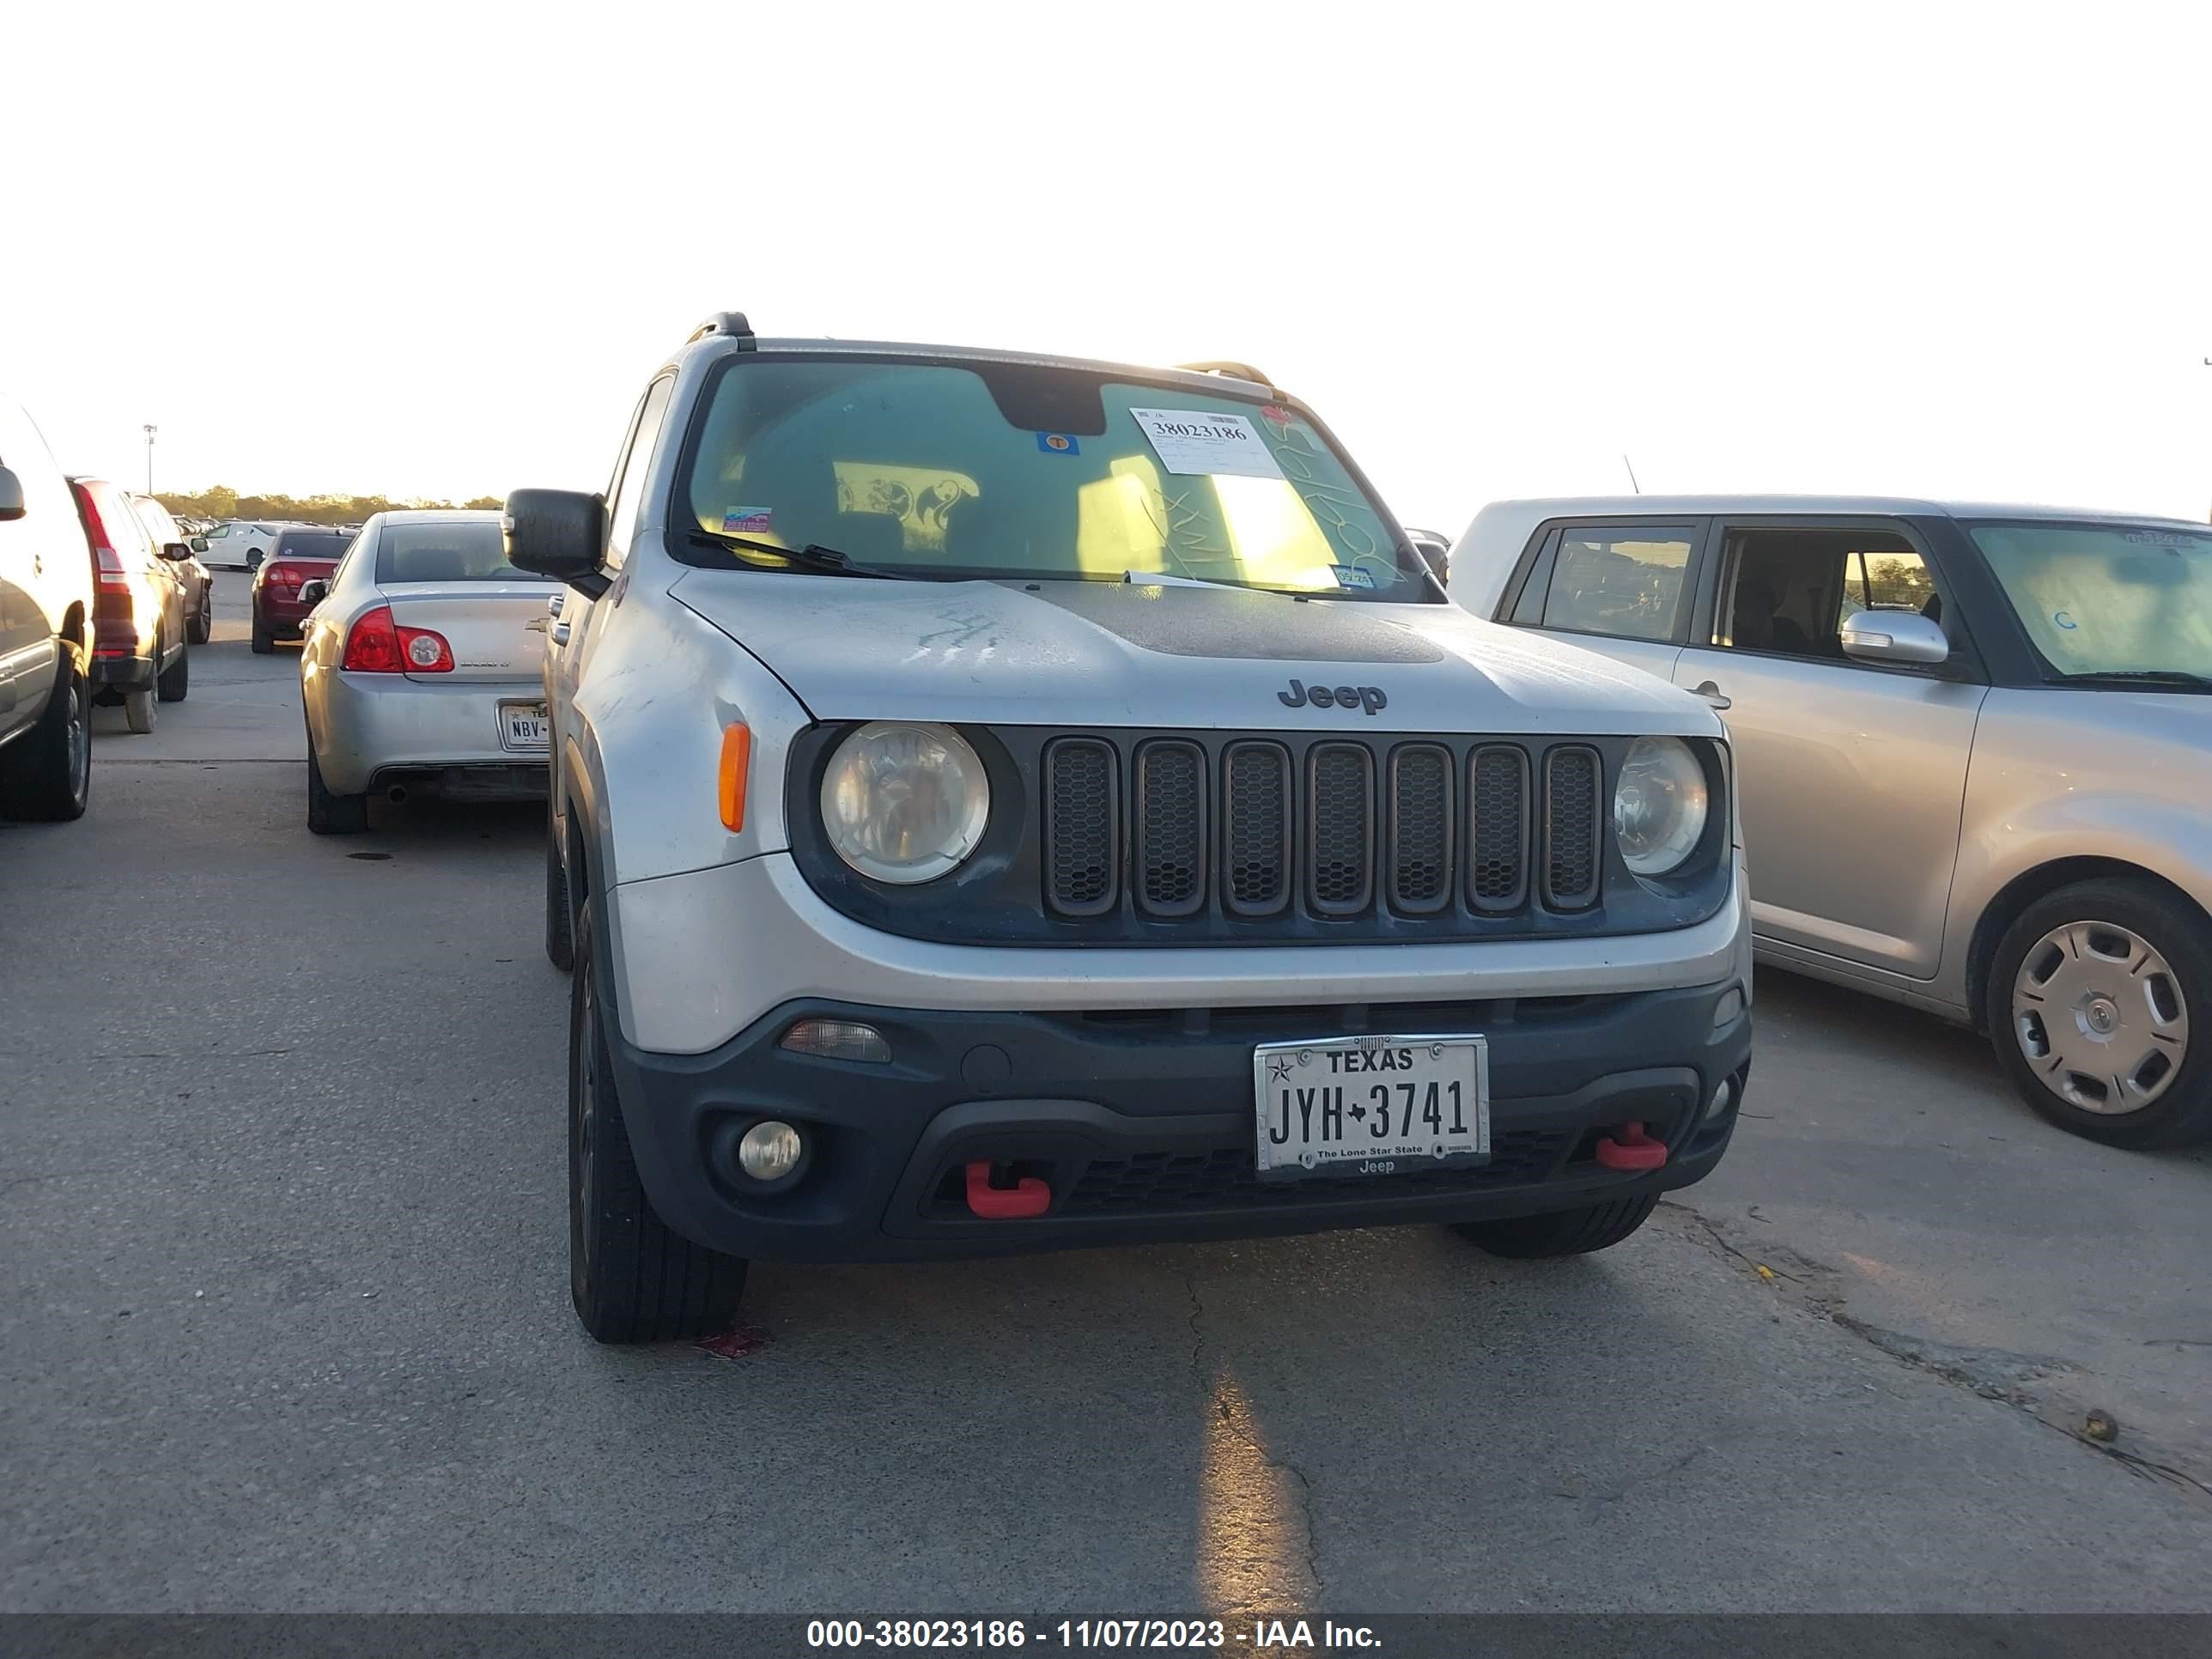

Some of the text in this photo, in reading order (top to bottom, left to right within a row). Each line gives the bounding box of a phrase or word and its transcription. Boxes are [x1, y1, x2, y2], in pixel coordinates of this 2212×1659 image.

[1152, 422, 1247, 441] 38023186
[1278, 679, 1388, 715] Jeep
[512, 721, 538, 737] NBV
[1327, 1048, 1413, 1073] TEXAS
[1340, 1148, 1366, 1157] Lone
[1370, 1146, 1392, 1155] Star
[1359, 1160, 1395, 1174] Jeep
